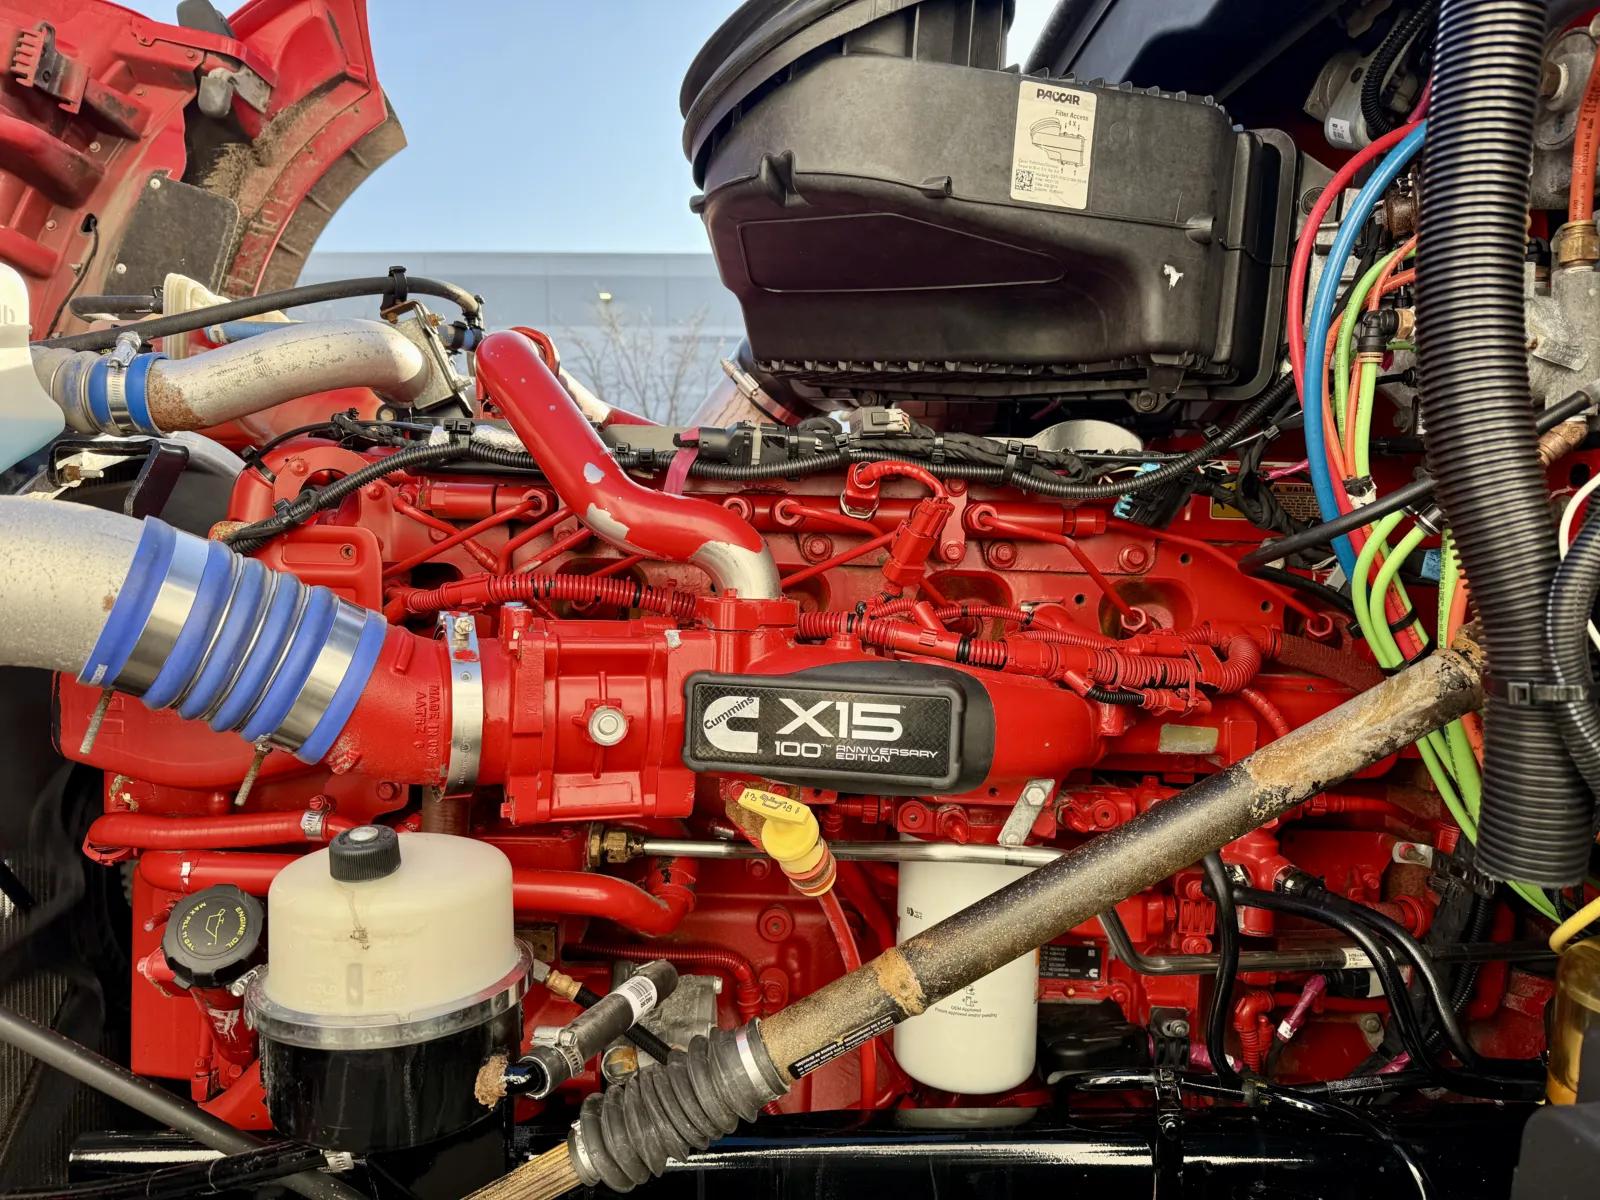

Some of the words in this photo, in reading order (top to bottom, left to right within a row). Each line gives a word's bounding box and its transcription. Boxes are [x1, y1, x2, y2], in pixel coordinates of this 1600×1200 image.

[1037, 88, 1080, 106] PACCAR
[1055, 109, 1069, 118] Filter
[1069, 111, 1089, 122] Access
[429, 685, 440, 720] MADE
[704, 696, 755, 731] Cummins
[775, 697, 905, 742] X15
[428, 724, 440, 736] IN
[835, 745, 939, 760] ANNIVERSARY
[835, 753, 892, 763] EDITION
[190, 902, 207, 915] MAX
[234, 906, 248, 935] ENGINE
[225, 937, 239, 949] OIL
